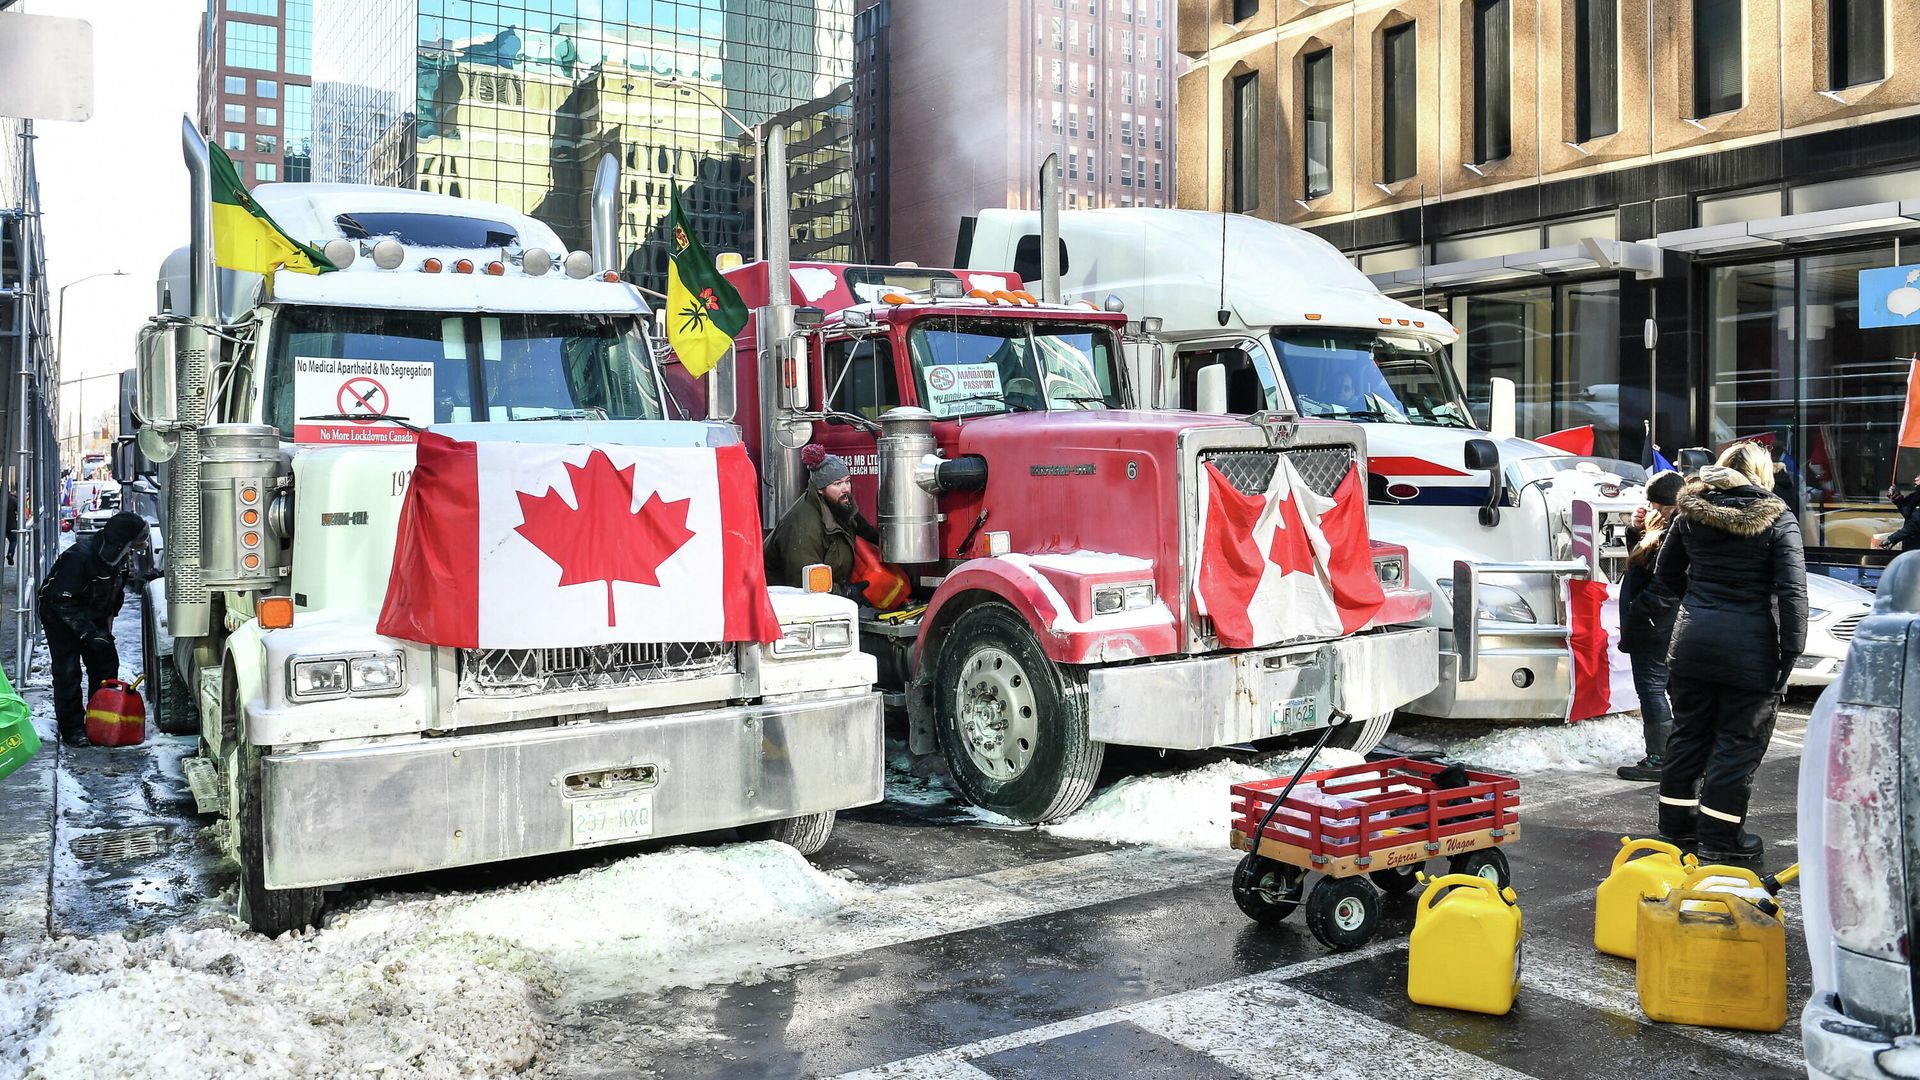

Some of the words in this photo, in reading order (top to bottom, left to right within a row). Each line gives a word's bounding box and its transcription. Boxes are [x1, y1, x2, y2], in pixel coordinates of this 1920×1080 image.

[297, 360, 307, 372] No
[309, 361, 335, 373] Medical
[337, 362, 371, 375] Apartheid
[373, 363, 379, 374] &
[380, 363, 389, 375] No
[391, 363, 432, 379] Segregation
[957, 370, 995, 379] MANDATORY
[963, 380, 994, 389] PASSPORT
[320, 429, 331, 440] No
[332, 430, 350, 440] More
[351, 430, 387, 441] Lockdowns
[389, 431, 413, 442] Canada
[854, 455, 865, 466] MB
[850, 466, 868, 475] BEACH
[869, 466, 879, 475] MB
[1126, 460, 1138, 480] 6
[577, 812, 607, 833] 237
[1387, 852, 1417, 866] Express
[1446, 839, 1475, 852] Wagon
